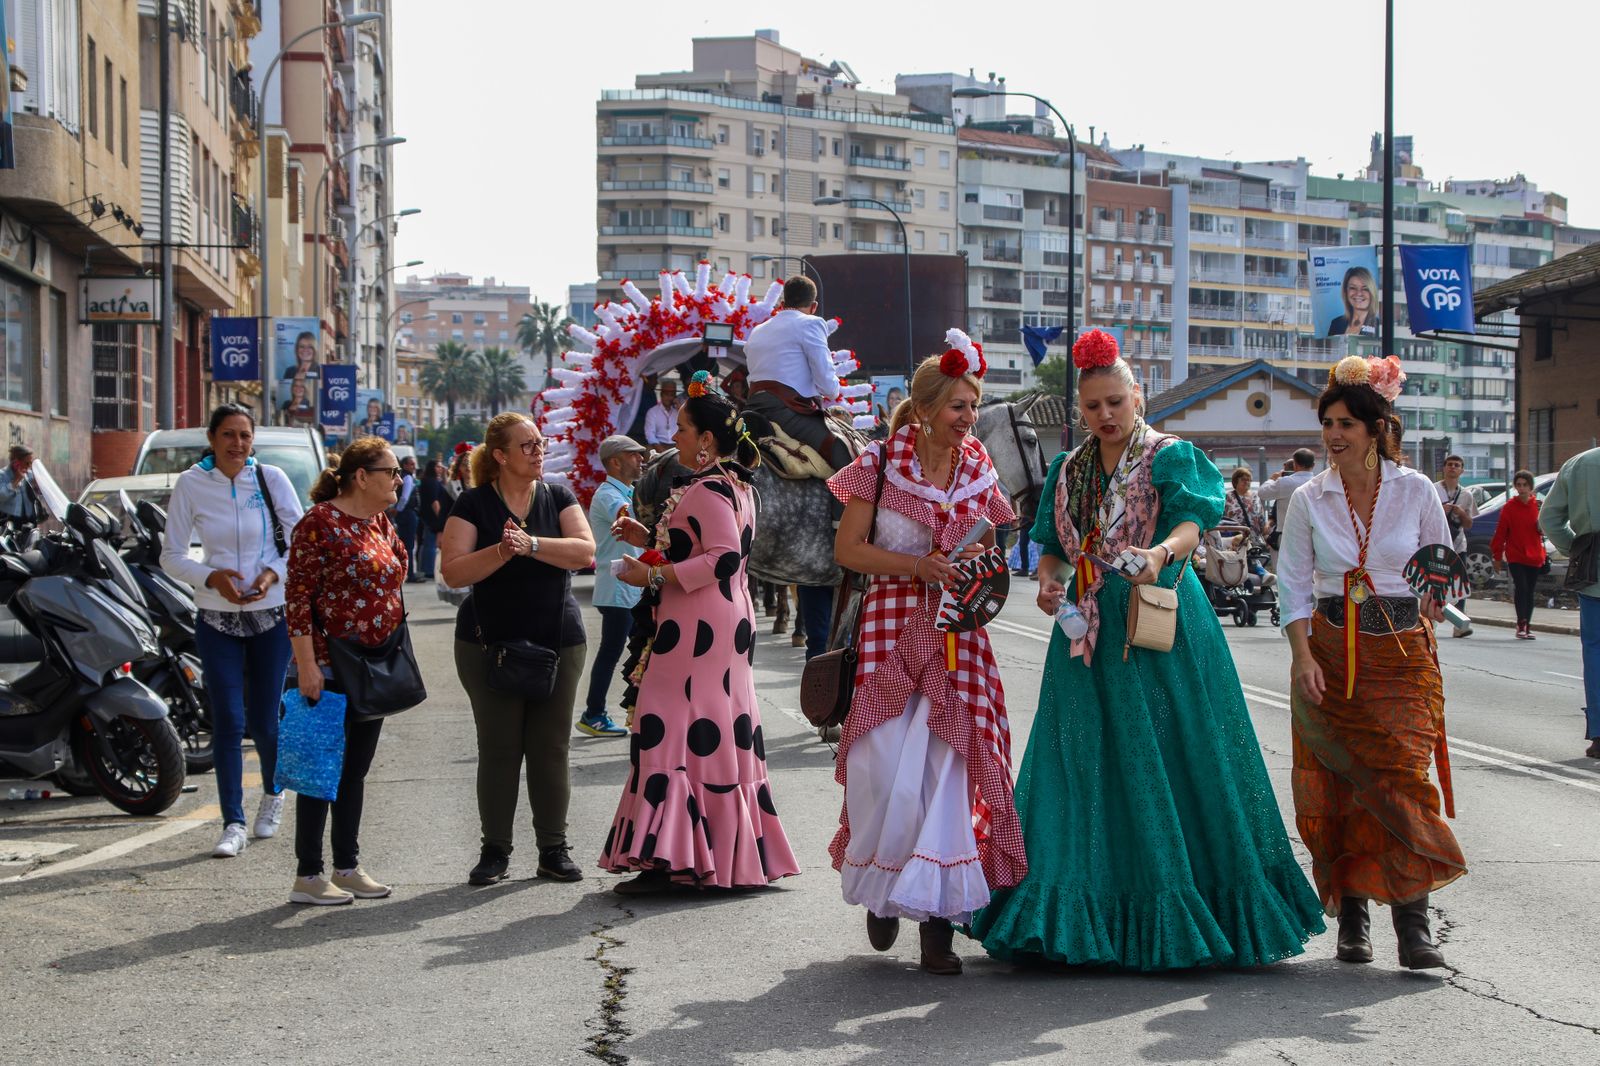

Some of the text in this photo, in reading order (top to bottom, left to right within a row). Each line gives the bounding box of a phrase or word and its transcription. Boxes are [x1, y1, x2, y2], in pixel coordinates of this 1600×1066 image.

[1418, 269, 1460, 281] VOTA
[89, 289, 149, 315] activa
[221, 335, 250, 345] VOTA
[328, 377, 350, 385] VOTA
